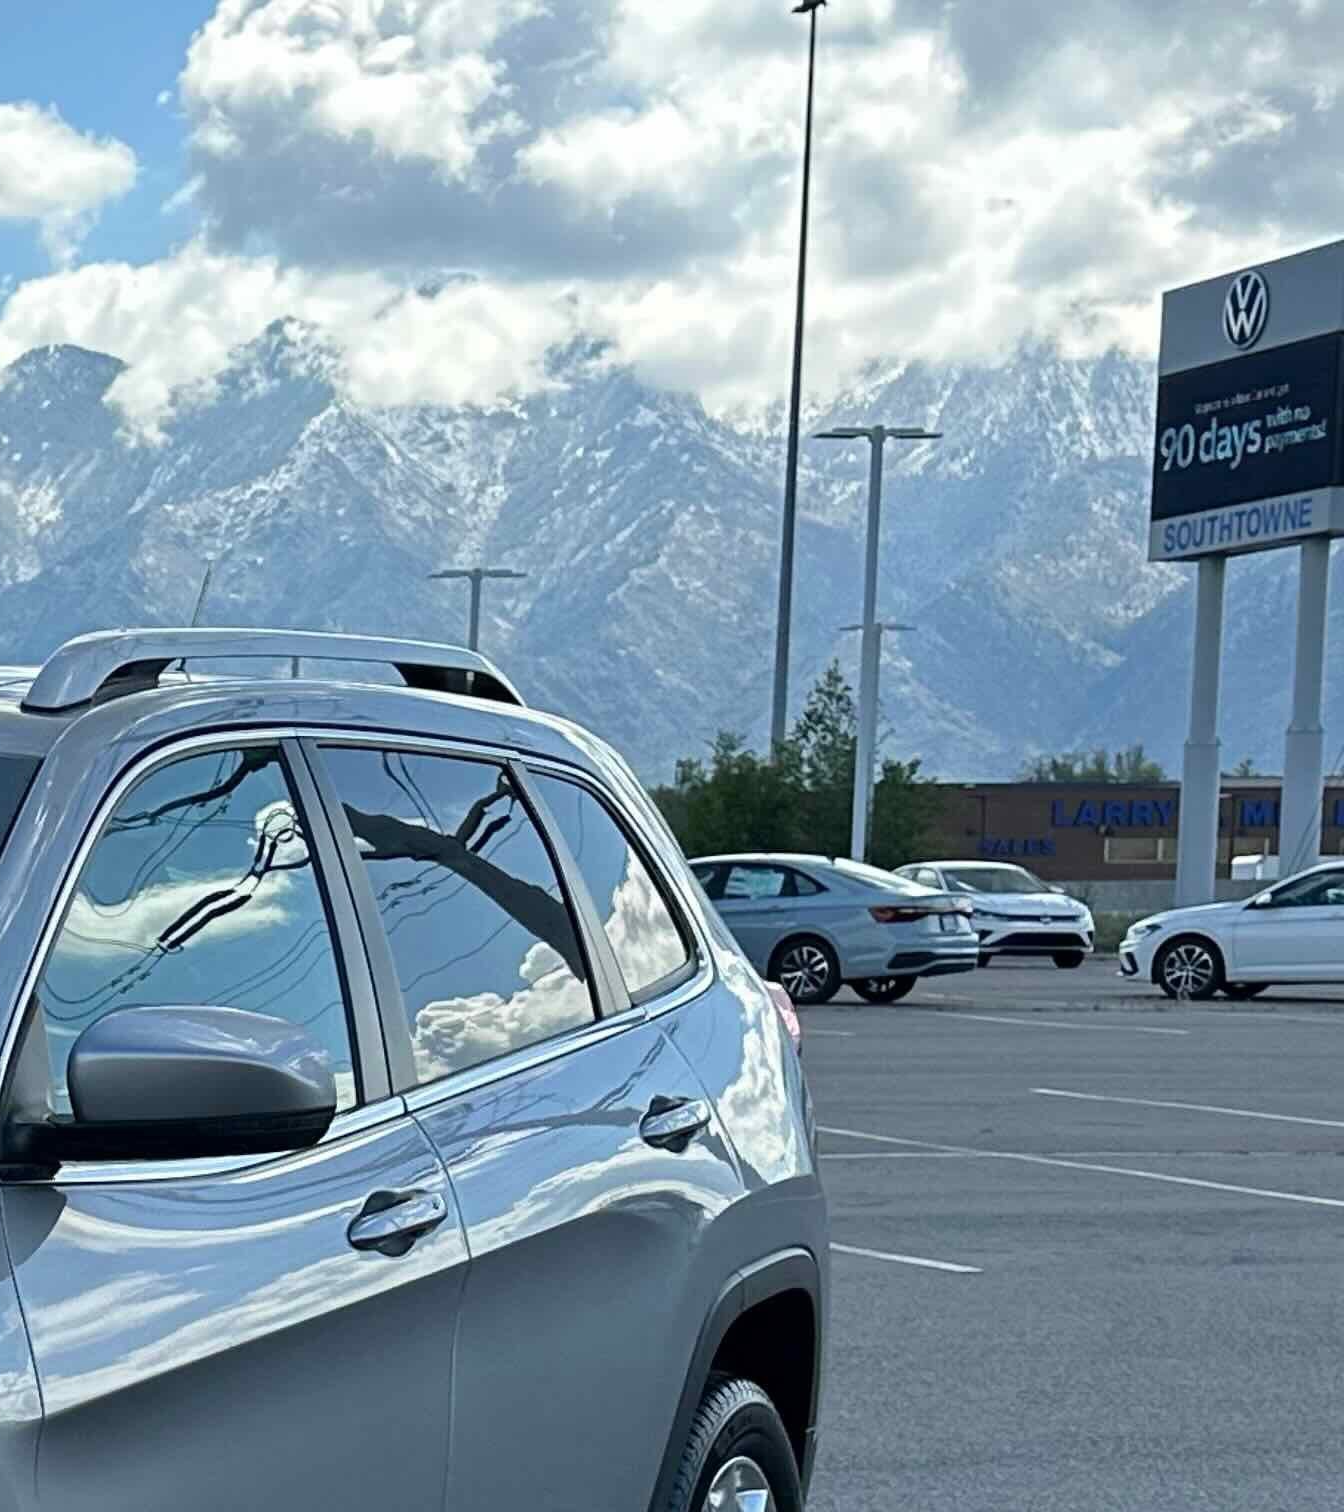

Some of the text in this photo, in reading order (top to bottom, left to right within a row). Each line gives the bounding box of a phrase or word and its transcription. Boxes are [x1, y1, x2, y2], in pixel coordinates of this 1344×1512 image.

[1161, 414, 1262, 471] 90 days
[1163, 497, 1313, 552] SOUTHTOWNE
[1051, 799, 1175, 828] LARRY
